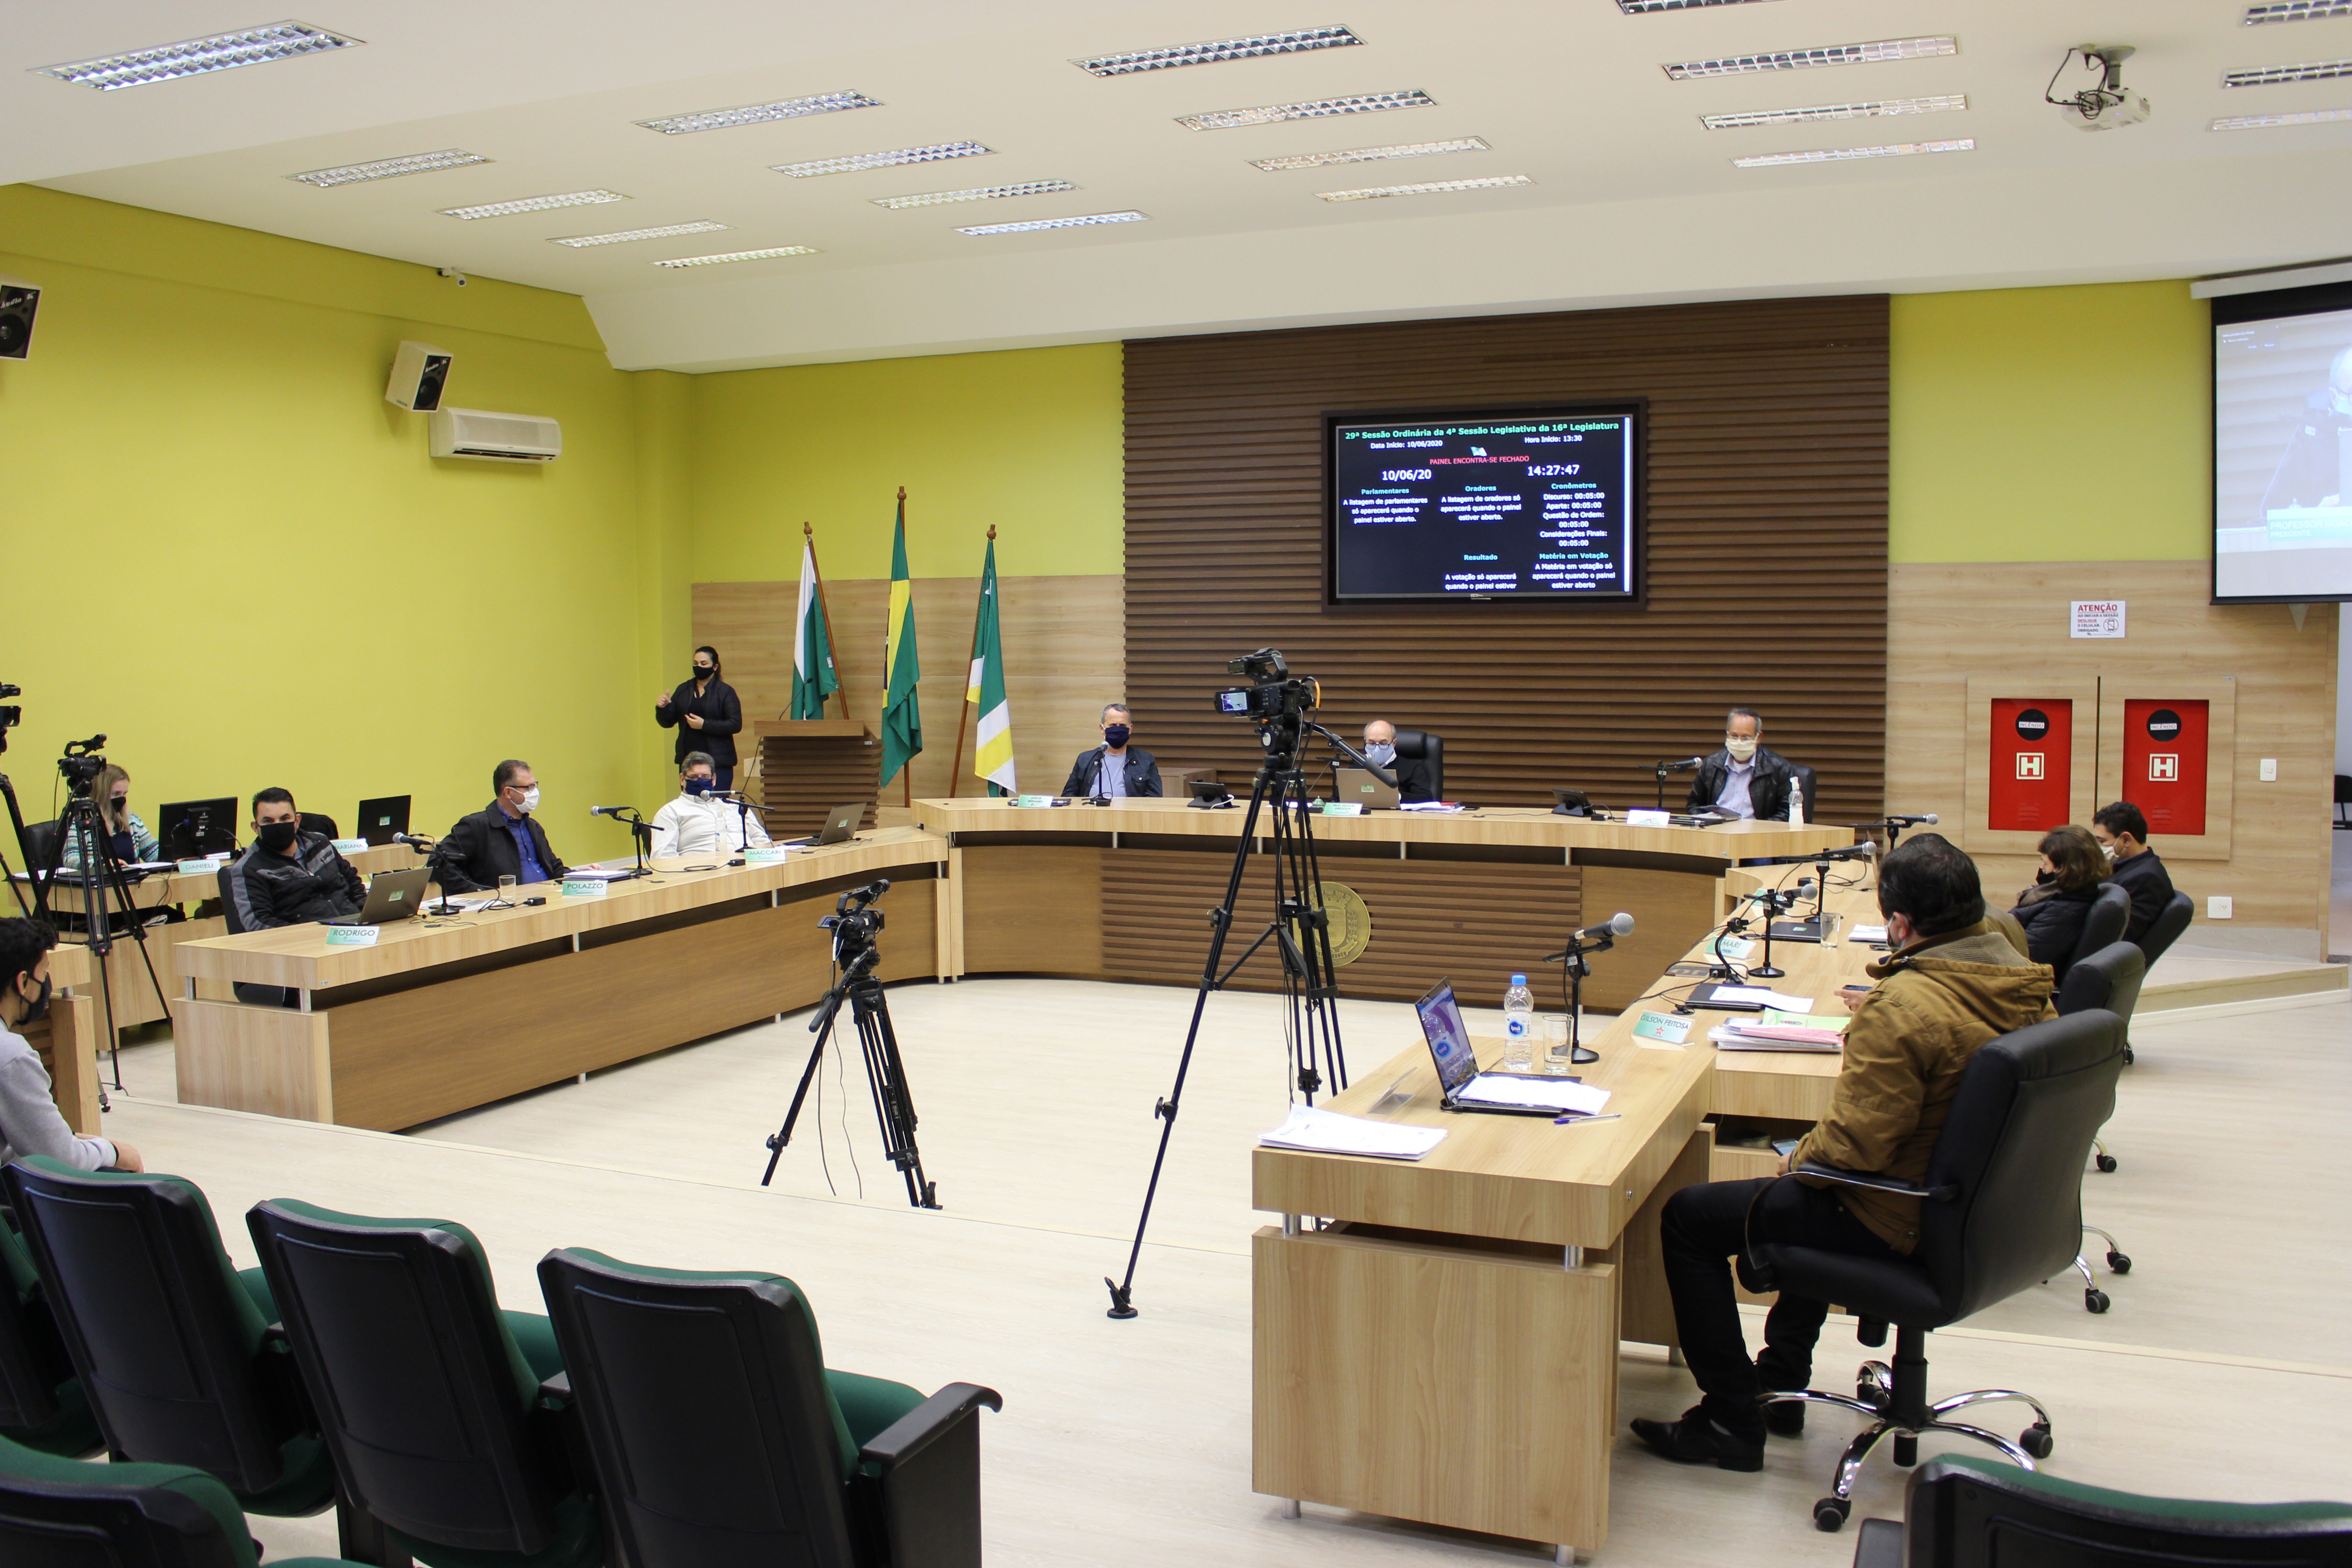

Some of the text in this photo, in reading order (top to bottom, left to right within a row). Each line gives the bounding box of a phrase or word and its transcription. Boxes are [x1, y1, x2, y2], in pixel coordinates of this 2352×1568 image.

[1362, 431, 1391, 439] Sessão
[1392, 429, 1431, 438] Ordinária
[1458, 426, 1488, 435] Sessão
[1490, 425, 1536, 435] Legislativa
[1570, 422, 1619, 432] Legislatura
[1527, 464, 1580, 476] 14:27:47
[1382, 469, 1431, 481] 10/06/20
[1385, 497, 1428, 506] parlamentares
[1361, 507, 1390, 515] aparecerá
[1391, 506, 1413, 514] quando
[1441, 505, 1471, 513] aparecerá
[1472, 504, 1495, 512] quando
[1503, 504, 1522, 512] painel
[1354, 516, 1372, 524] painel
[1543, 511, 1569, 520] Questão
[2270, 520, 2322, 530] PROFESSOR
[1540, 530, 1585, 539] Considerações
[1578, 562, 1603, 571] votação
[1451, 573, 1475, 581] votação
[1485, 573, 1517, 581] aparecerá
[1532, 572, 1563, 580] aparecerá
[1565, 572, 1589, 580] quando
[1596, 572, 1616, 580] painel
[1445, 583, 1468, 591] quando
[1475, 582, 1494, 590] painel
[2078, 603, 2118, 613] ATENÇÃO
[2020, 757, 2040, 775] H
[2153, 758, 2174, 777] H
[1721, 940, 1741, 948] MARI
[1640, 1015, 1689, 1029] GILSON FEITOSA
